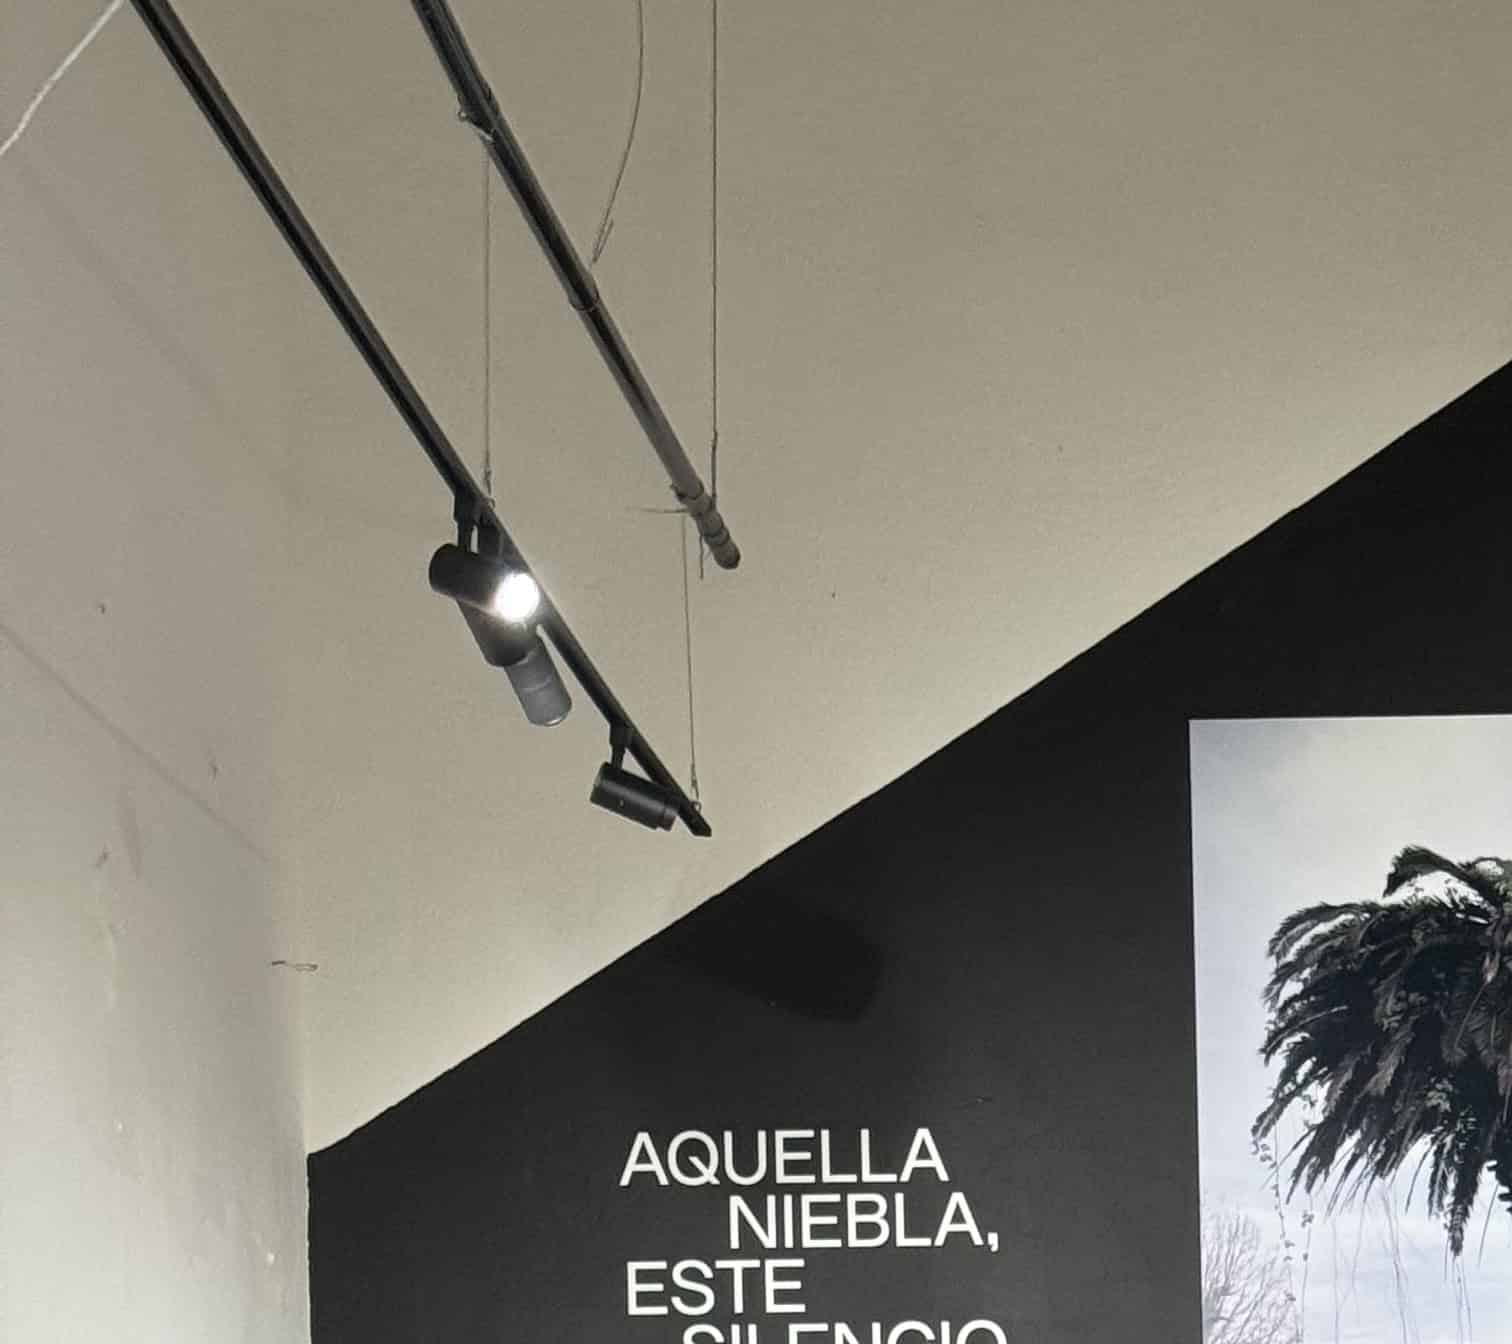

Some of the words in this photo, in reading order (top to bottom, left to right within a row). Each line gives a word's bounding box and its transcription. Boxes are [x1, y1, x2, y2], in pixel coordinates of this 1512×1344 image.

[619, 1127, 950, 1187] AQUELLA
[729, 1191, 999, 1253] NIEBLA,
[626, 1258, 806, 1316] ESTE
